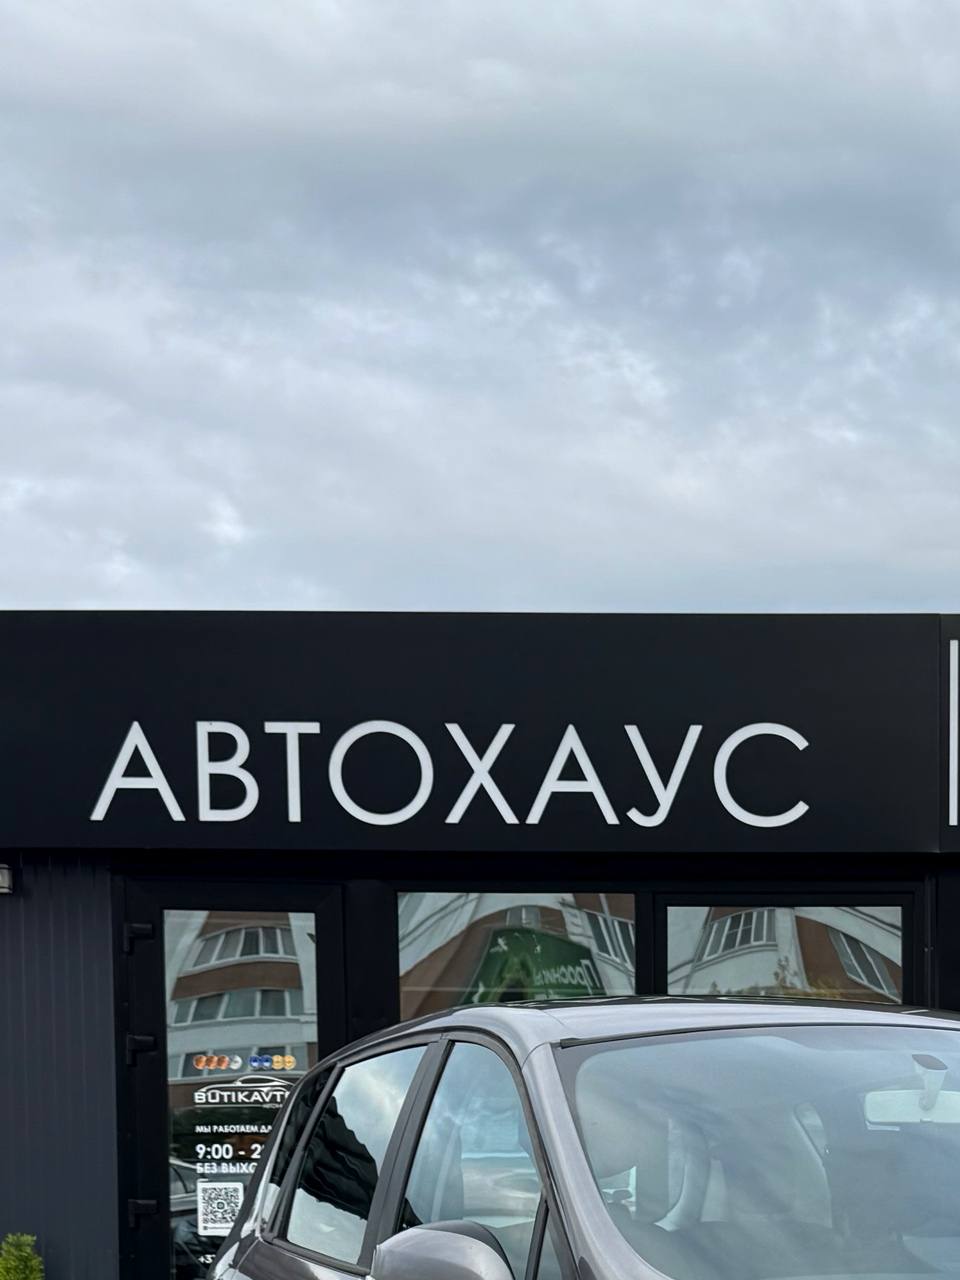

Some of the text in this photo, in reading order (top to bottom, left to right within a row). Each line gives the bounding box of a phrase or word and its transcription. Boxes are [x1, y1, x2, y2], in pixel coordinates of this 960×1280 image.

[90, 719, 811, 828] АВТОХАУС
[194, 1091, 289, 1104] BUTIKAVT
[195, 1125, 211, 1133] МЫ
[212, 1125, 259, 1133] РАБОТАЕМ
[195, 1143, 234, 1159] 9:00
[195, 1162, 218, 1174] БЕЗ
